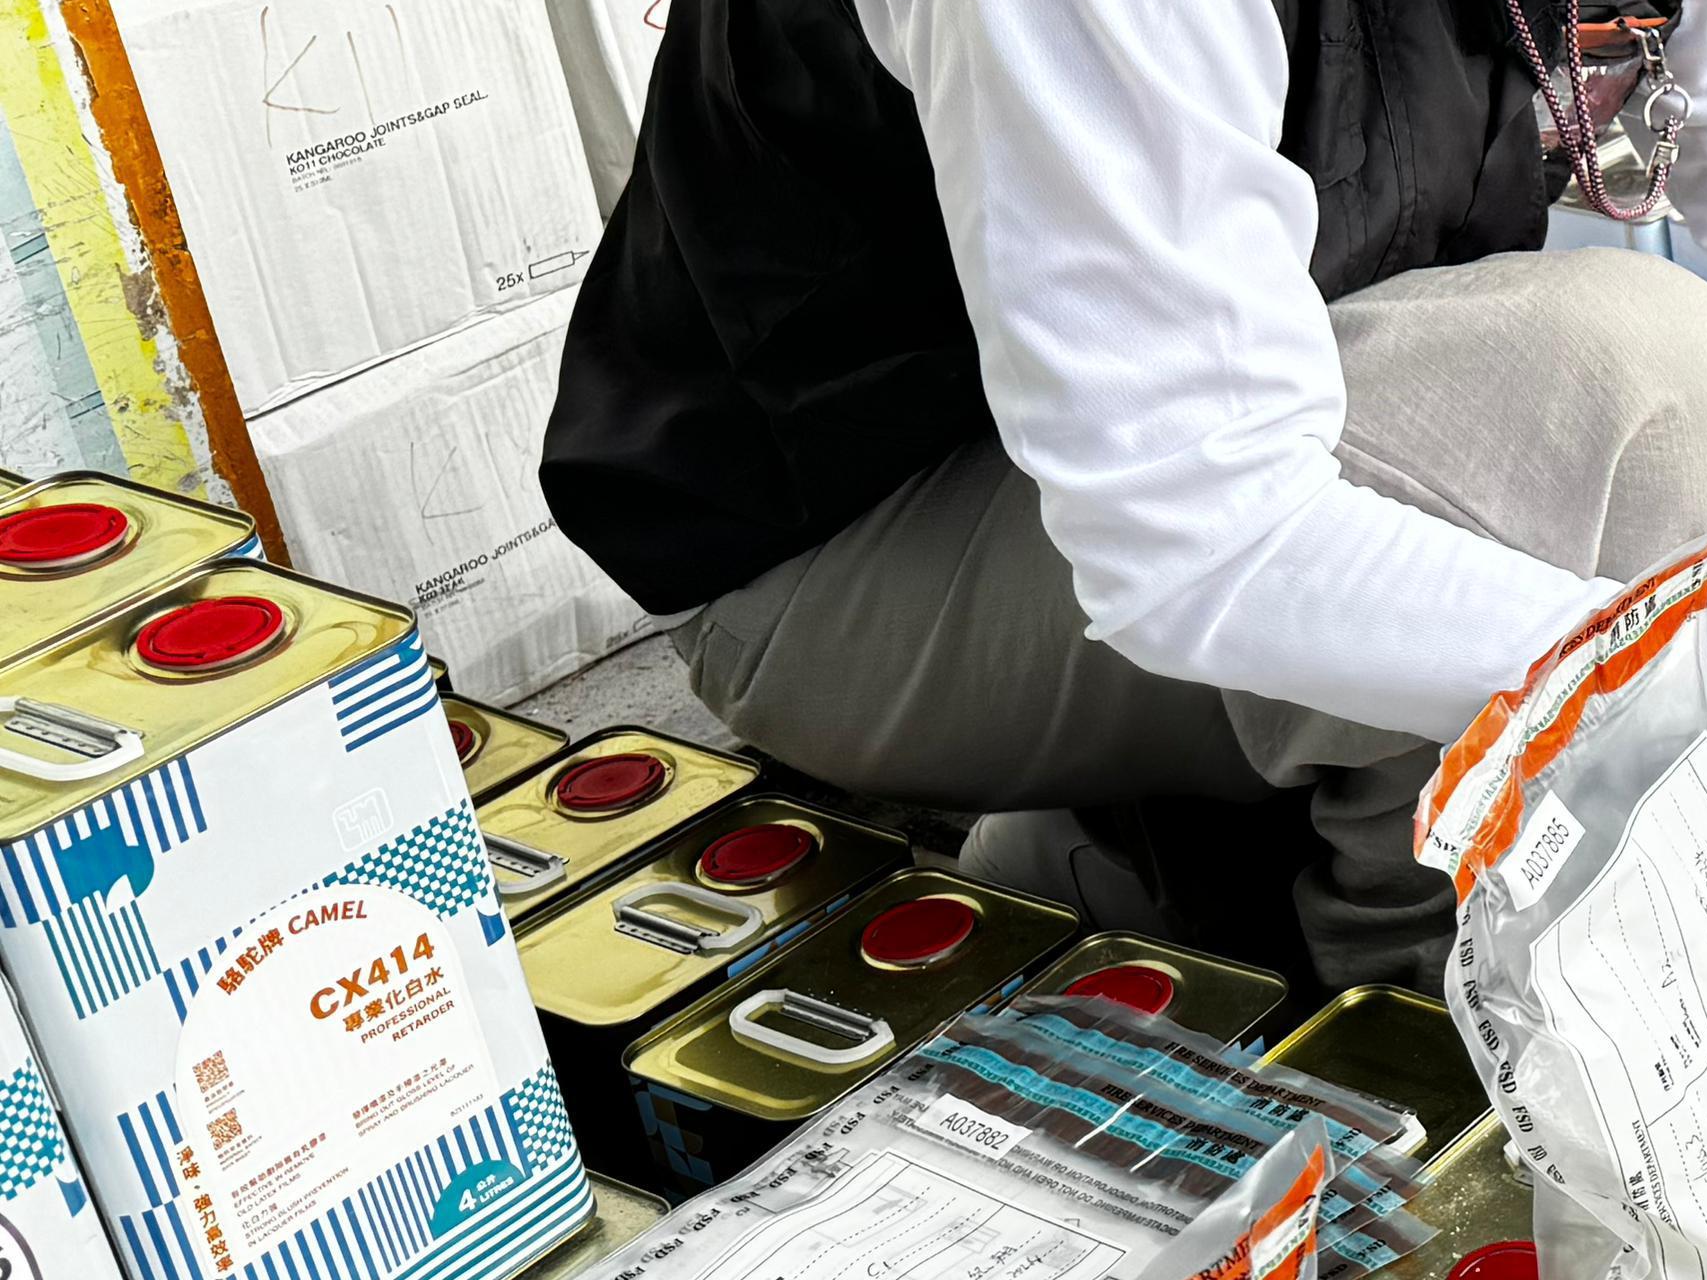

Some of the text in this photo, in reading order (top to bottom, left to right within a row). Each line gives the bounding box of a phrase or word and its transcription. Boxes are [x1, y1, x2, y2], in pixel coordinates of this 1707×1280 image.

[286, 132, 366, 166] KANGAROO
[370, 102, 451, 138] JOINTS&GAP
[496, 272, 525, 291] 25x
[415, 518, 557, 595] KANGAROO JOINTS&GA
[1519, 816, 1571, 891] A037885
[287, 899, 368, 936] CAMEL
[309, 931, 436, 1021] CX414
[360, 985, 453, 1045] PROFESSIONAL
[391, 998, 456, 1043] RETARDER
[1478, 1019, 1500, 1053] FSD
[1164, 1041, 1326, 1108] FIRE SERVICES DEPARTMENT
[1498, 1060, 1518, 1095] FSD
[940, 1111, 1010, 1151] A037882
[1101, 1083, 1129, 1101] FIRE
[1185, 1117, 1263, 1150] DEPARTMENT
[1511, 1105, 1534, 1135] FSD
[458, 1188, 477, 1212] 4
